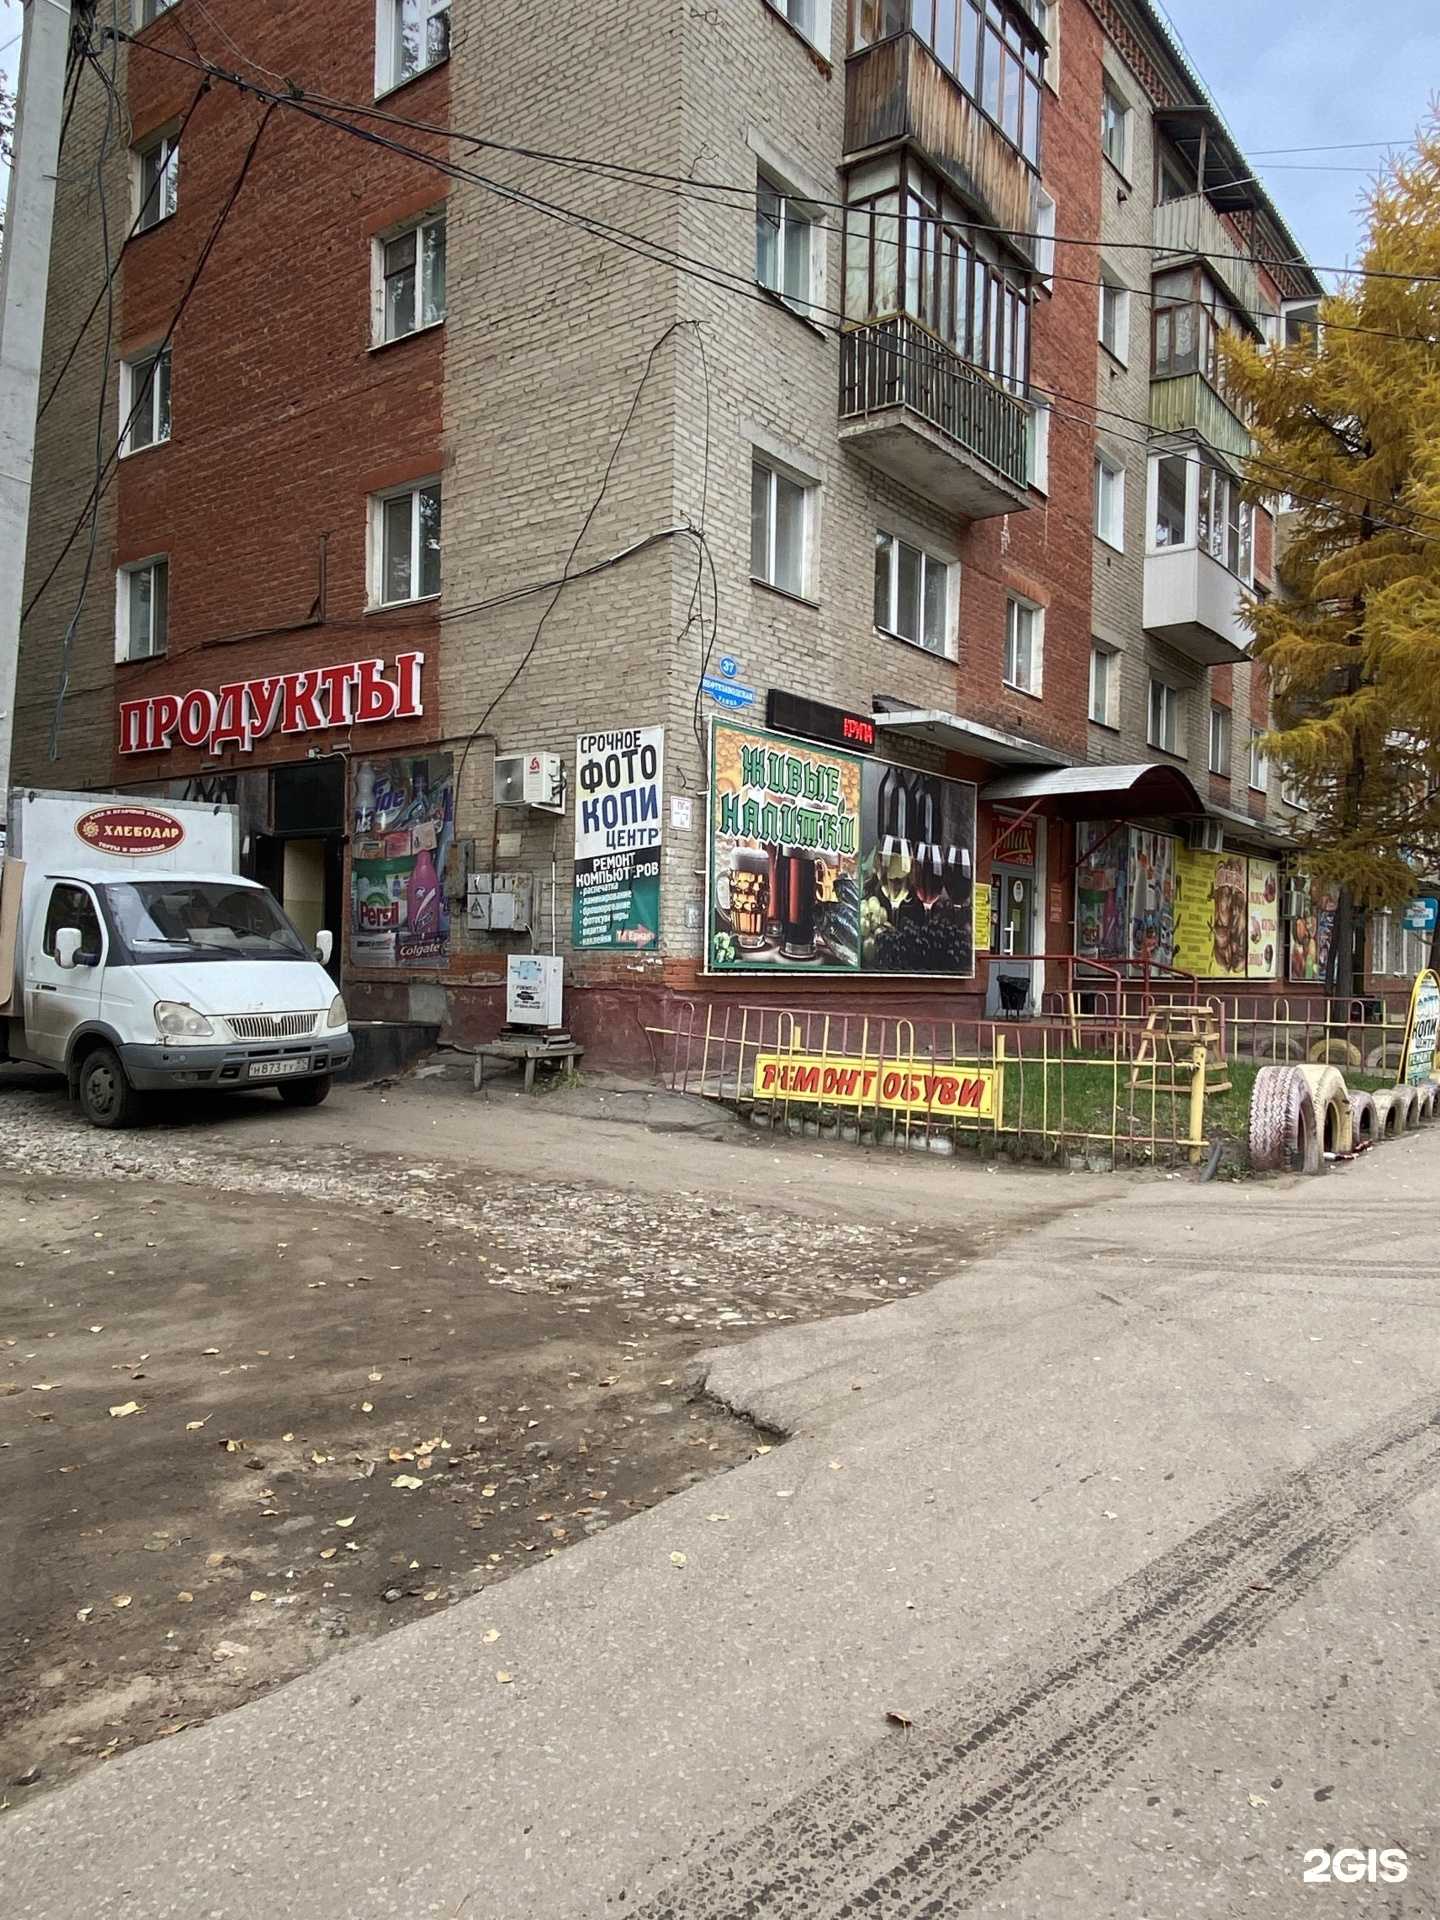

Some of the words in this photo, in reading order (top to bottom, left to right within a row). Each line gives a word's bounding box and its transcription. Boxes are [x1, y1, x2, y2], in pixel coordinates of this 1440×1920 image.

[723, 660, 735, 673] 37
[119, 651, 425, 755] ПРОДУКТЫ
[580, 730, 641, 753] СРОЧНОЕ
[580, 744, 657, 793] ФОТО
[741, 745, 840, 806] ЖИВЫЕ
[582, 784, 658, 834] КОПИ
[719, 793, 856, 855] НАПИТКИ
[103, 825, 179, 839] ХЛЕБОДАР
[606, 827, 659, 850] ЦЕНТР
[593, 852, 636, 872] РЕМОНТ
[400, 943, 441, 957] Colgate
[762, 1064, 877, 1097] РЕМОНТ
[882, 1071, 985, 1107] ОБУВИ
